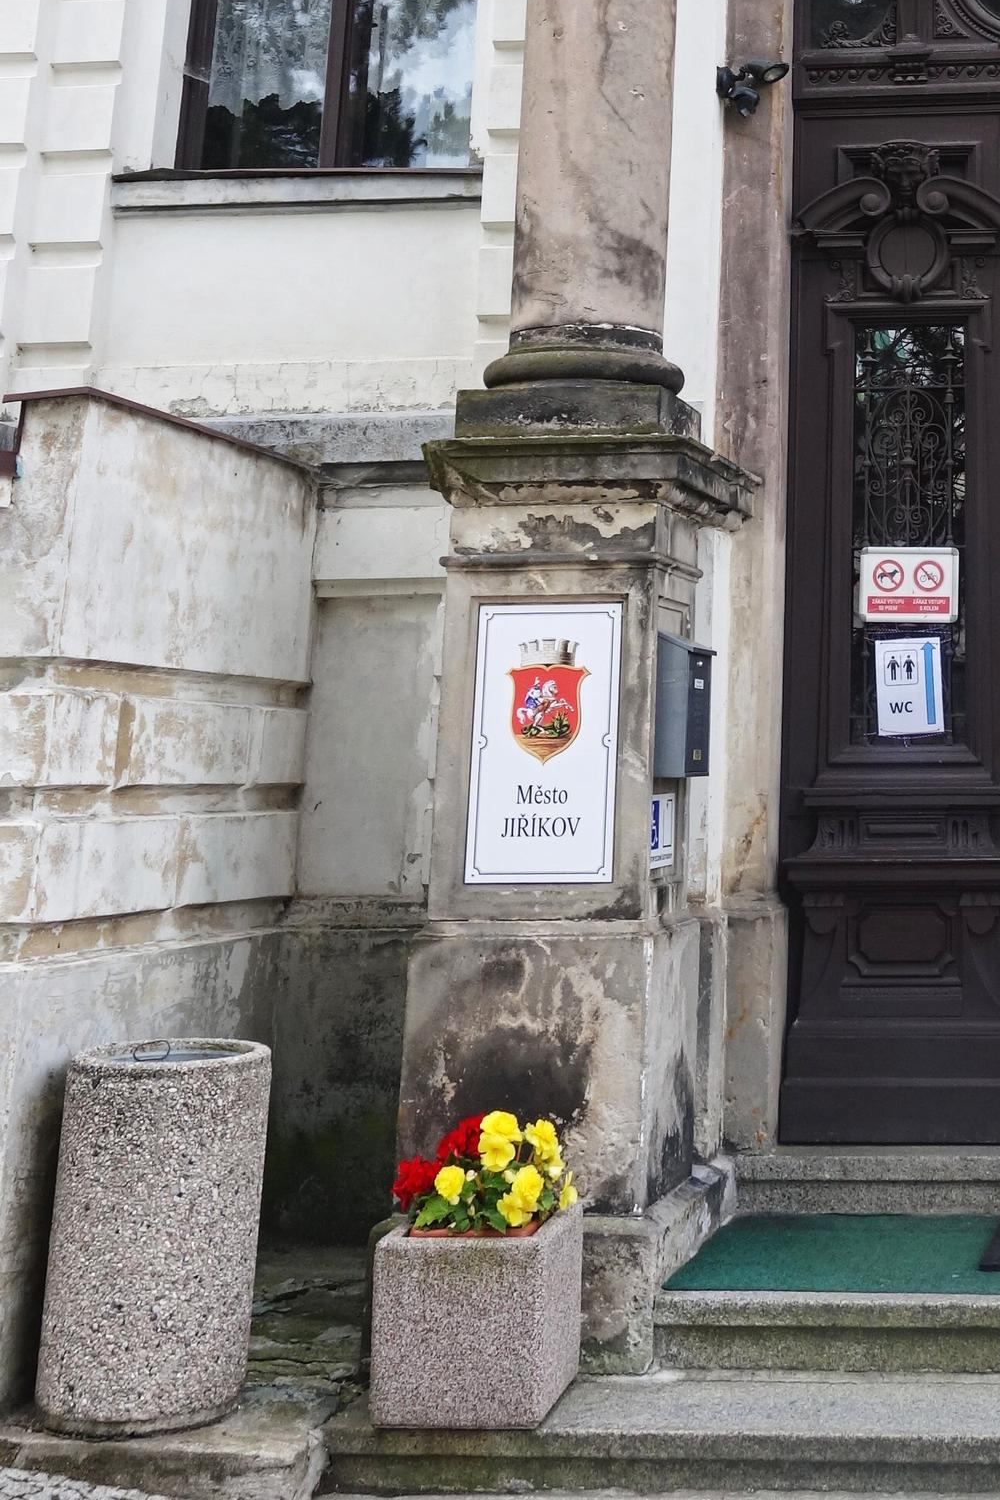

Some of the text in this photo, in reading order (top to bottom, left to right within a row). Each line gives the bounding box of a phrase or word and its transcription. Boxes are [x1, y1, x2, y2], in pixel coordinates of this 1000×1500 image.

[889, 701, 913, 714] WC
[515, 784, 569, 805] Město
[500, 813, 582, 838] JIŘÍKOV
